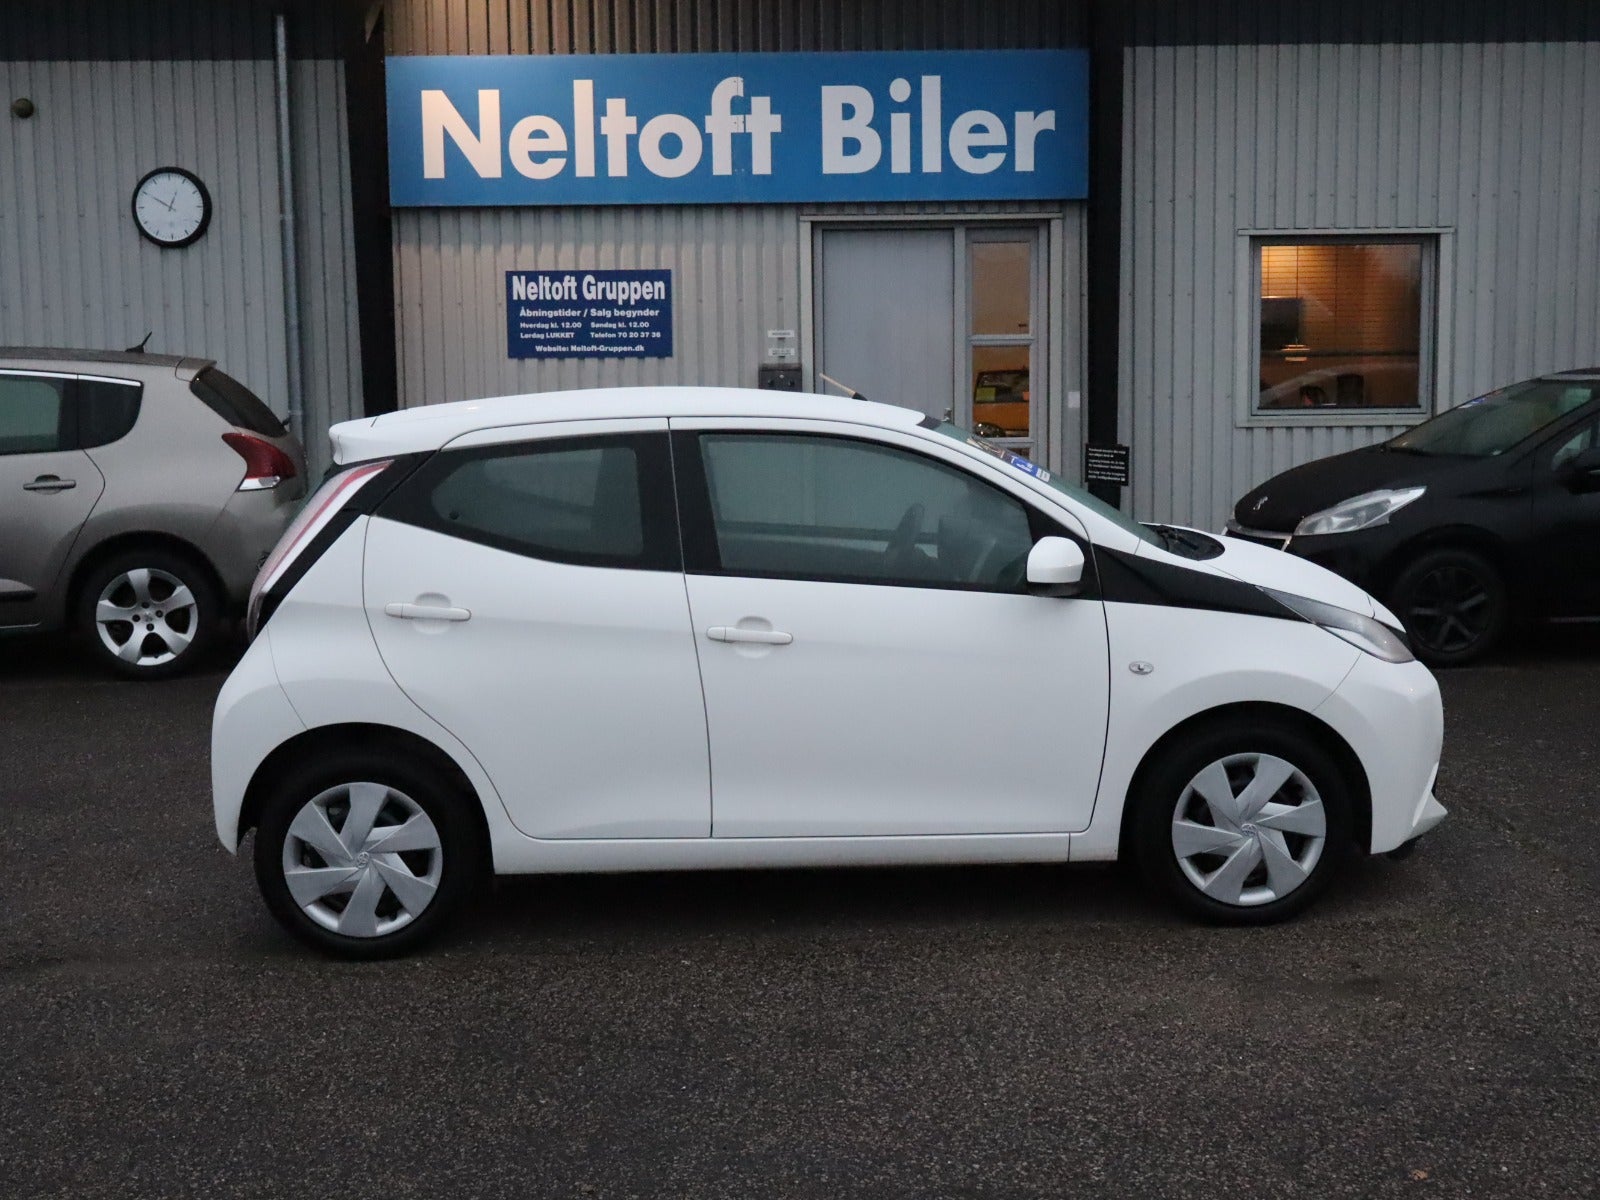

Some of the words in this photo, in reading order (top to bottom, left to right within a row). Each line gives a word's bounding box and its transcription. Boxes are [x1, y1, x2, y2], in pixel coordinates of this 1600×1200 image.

[420, 76, 783, 180] Neltoft
[820, 74, 1056, 175] Biler
[512, 275, 578, 301] Neltoft
[582, 274, 666, 305] Gruppen
[519, 306, 582, 318] Åbningstider
[583, 308, 588, 318] /
[590, 308, 612, 318] Salg
[613, 308, 660, 318] begynder
[590, 321, 617, 329] Søndag
[570, 344, 645, 353] Neltoft-Gruppen.dk
